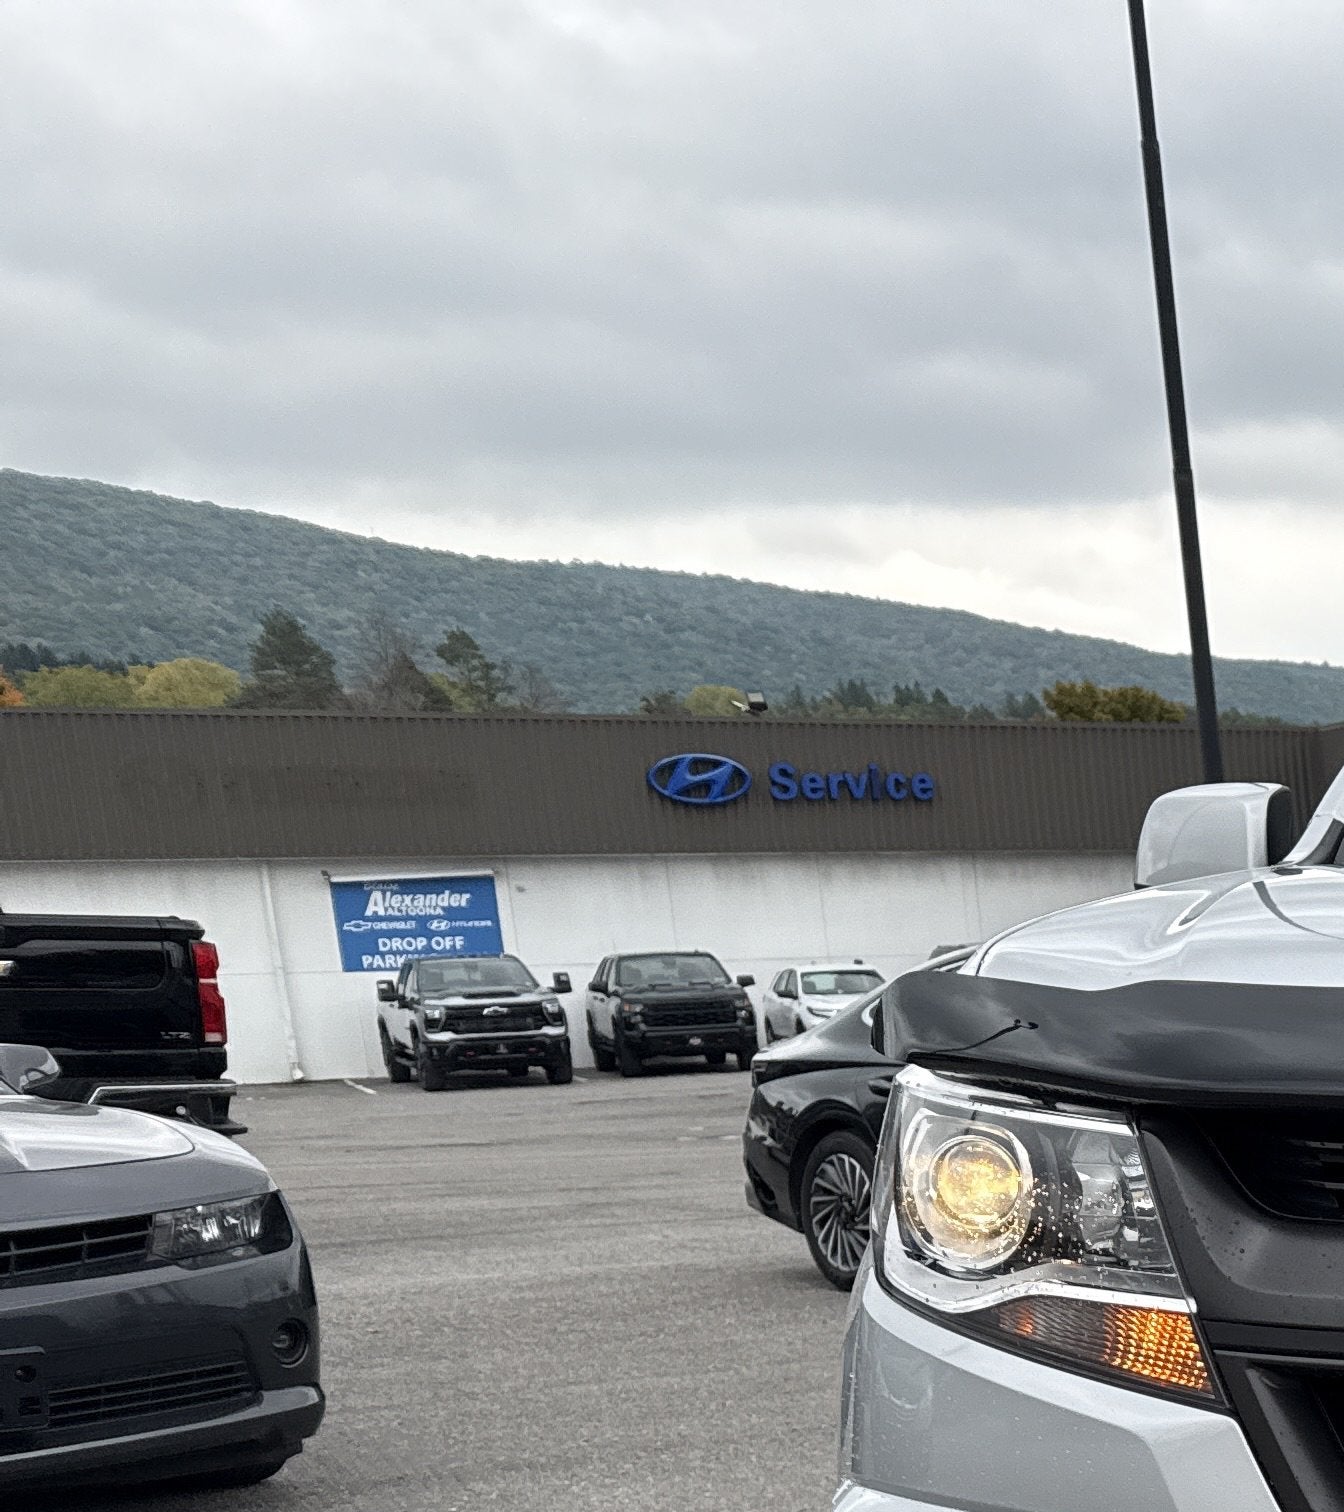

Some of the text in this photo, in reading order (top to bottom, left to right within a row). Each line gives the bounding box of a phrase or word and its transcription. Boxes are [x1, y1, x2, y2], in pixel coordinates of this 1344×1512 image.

[768, 761, 935, 801] Service
[364, 890, 472, 917] Alexander
[377, 936, 465, 952] DROP OFF
[361, 953, 437, 969] PARK
